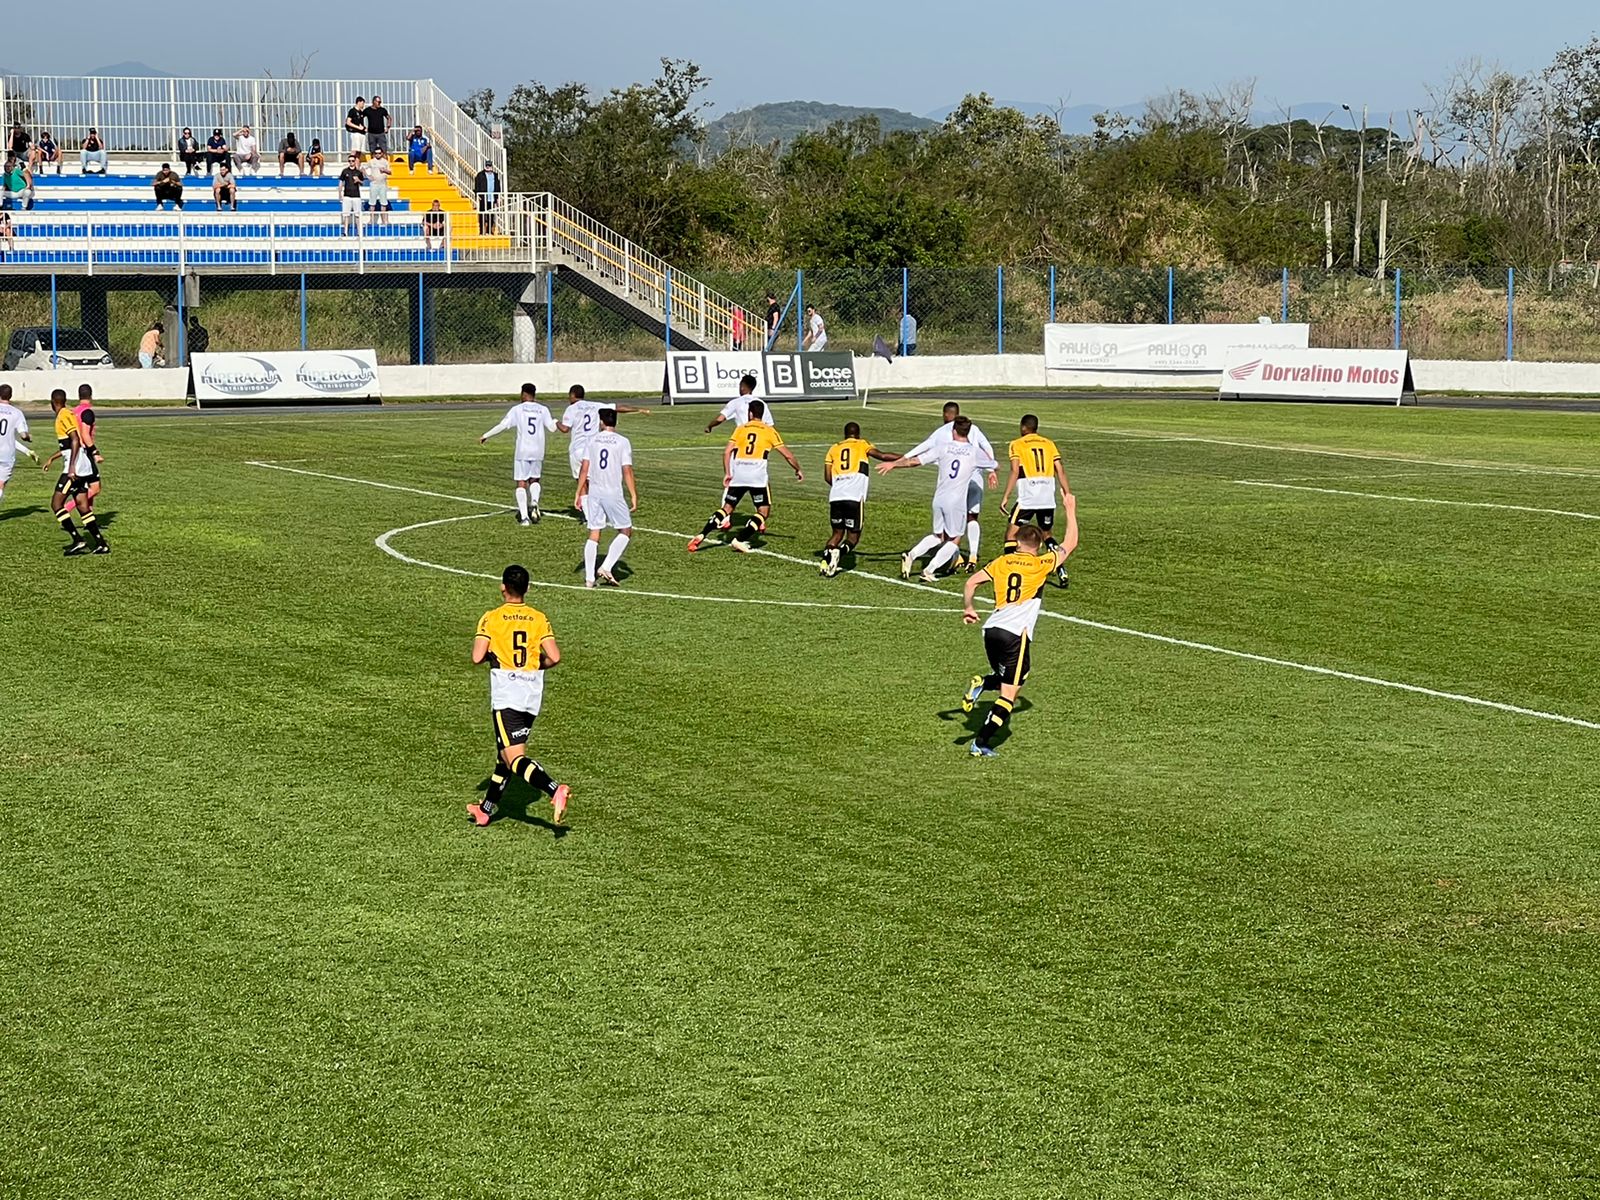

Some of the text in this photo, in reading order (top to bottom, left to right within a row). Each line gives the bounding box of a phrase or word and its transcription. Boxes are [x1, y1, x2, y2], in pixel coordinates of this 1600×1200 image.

[716, 361, 759, 380] base
[809, 361, 852, 380] base
[1262, 363, 1399, 385] Dorvalino Motos
[0, 418, 8, 436] 0
[527, 417, 537, 435] 5
[583, 414, 592, 432] 2
[745, 433, 757, 455] 3
[599, 448, 609, 470] 8
[841, 448, 851, 471] 9
[948, 459, 961, 479] 9
[1031, 447, 1045, 473] 11
[1006, 573, 1022, 603] 8
[512, 630, 528, 668] 5
